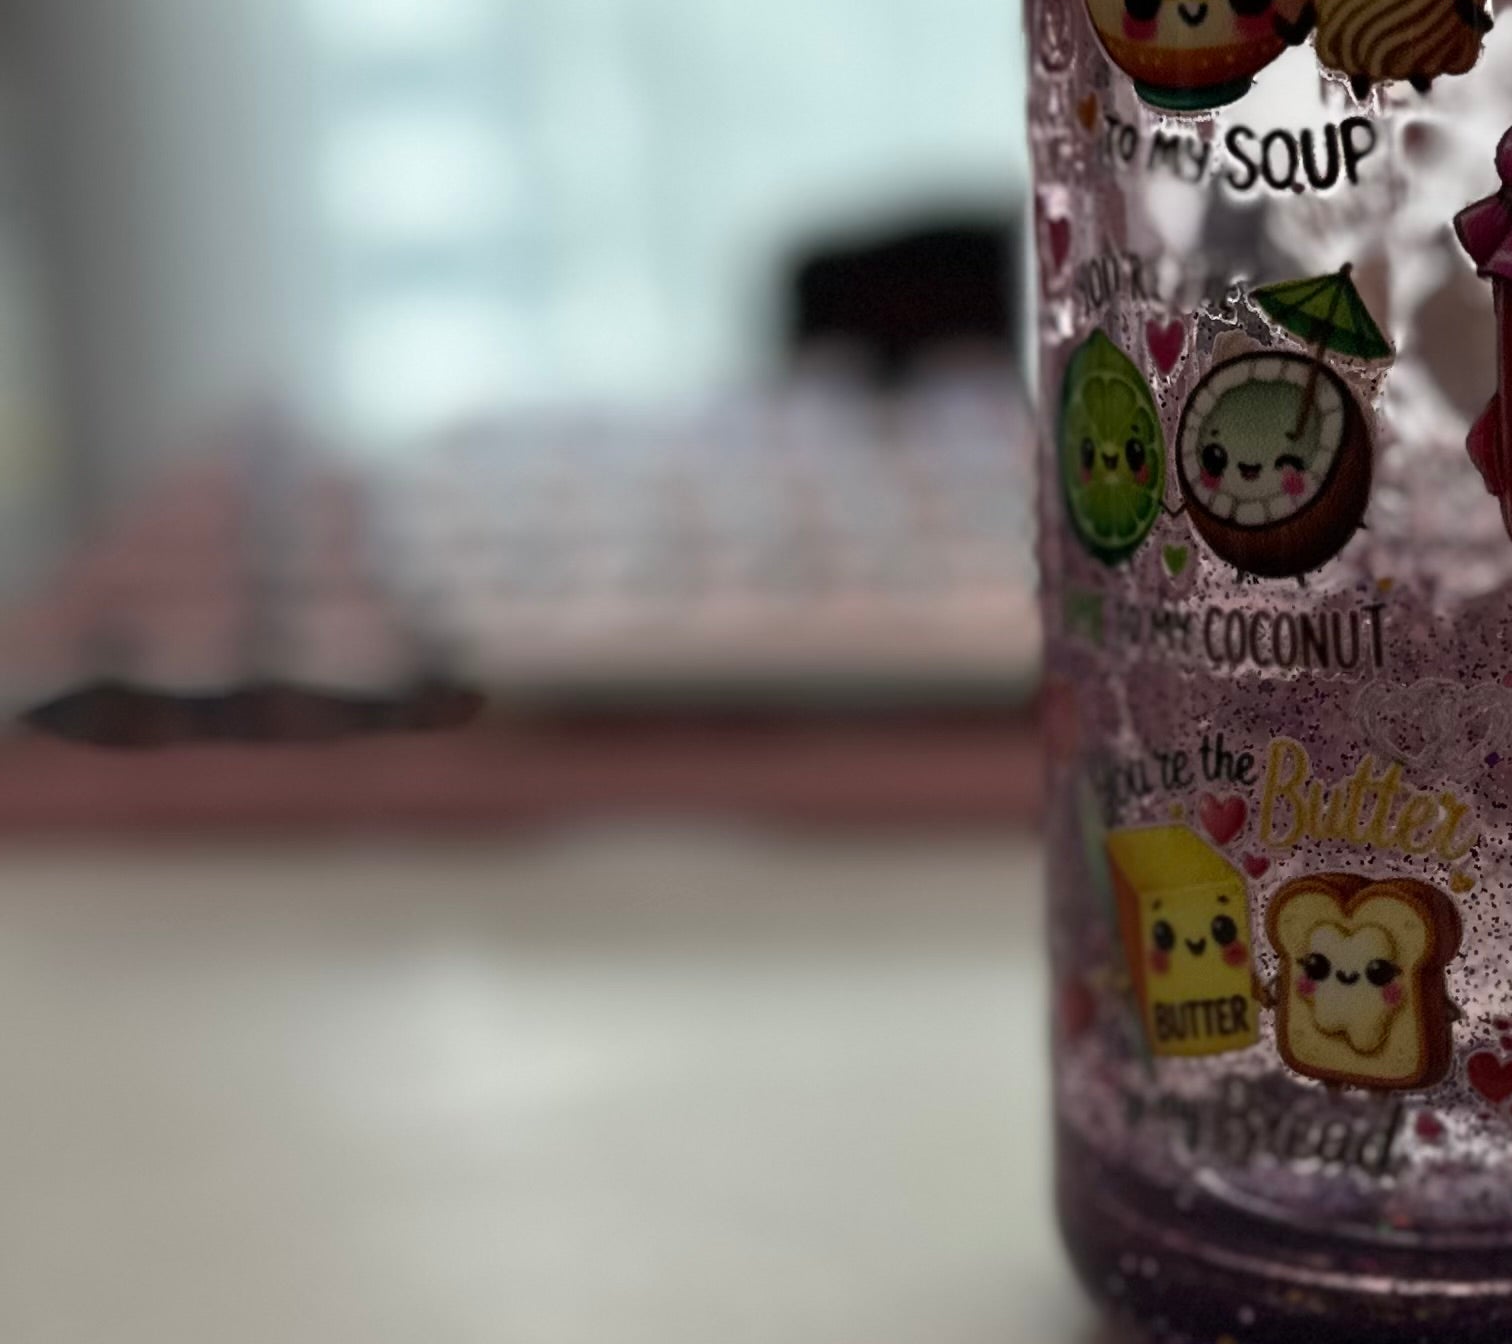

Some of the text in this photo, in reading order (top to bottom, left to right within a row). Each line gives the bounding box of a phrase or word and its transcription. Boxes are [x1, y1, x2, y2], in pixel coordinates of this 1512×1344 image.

[1104, 113, 1377, 191] TO MY SOUP
[1202, 602, 1386, 669] COCONUT
[1198, 730, 1259, 786] the
[1258, 735, 1480, 858] Butter
[1151, 993, 1250, 1044] BUTTER
